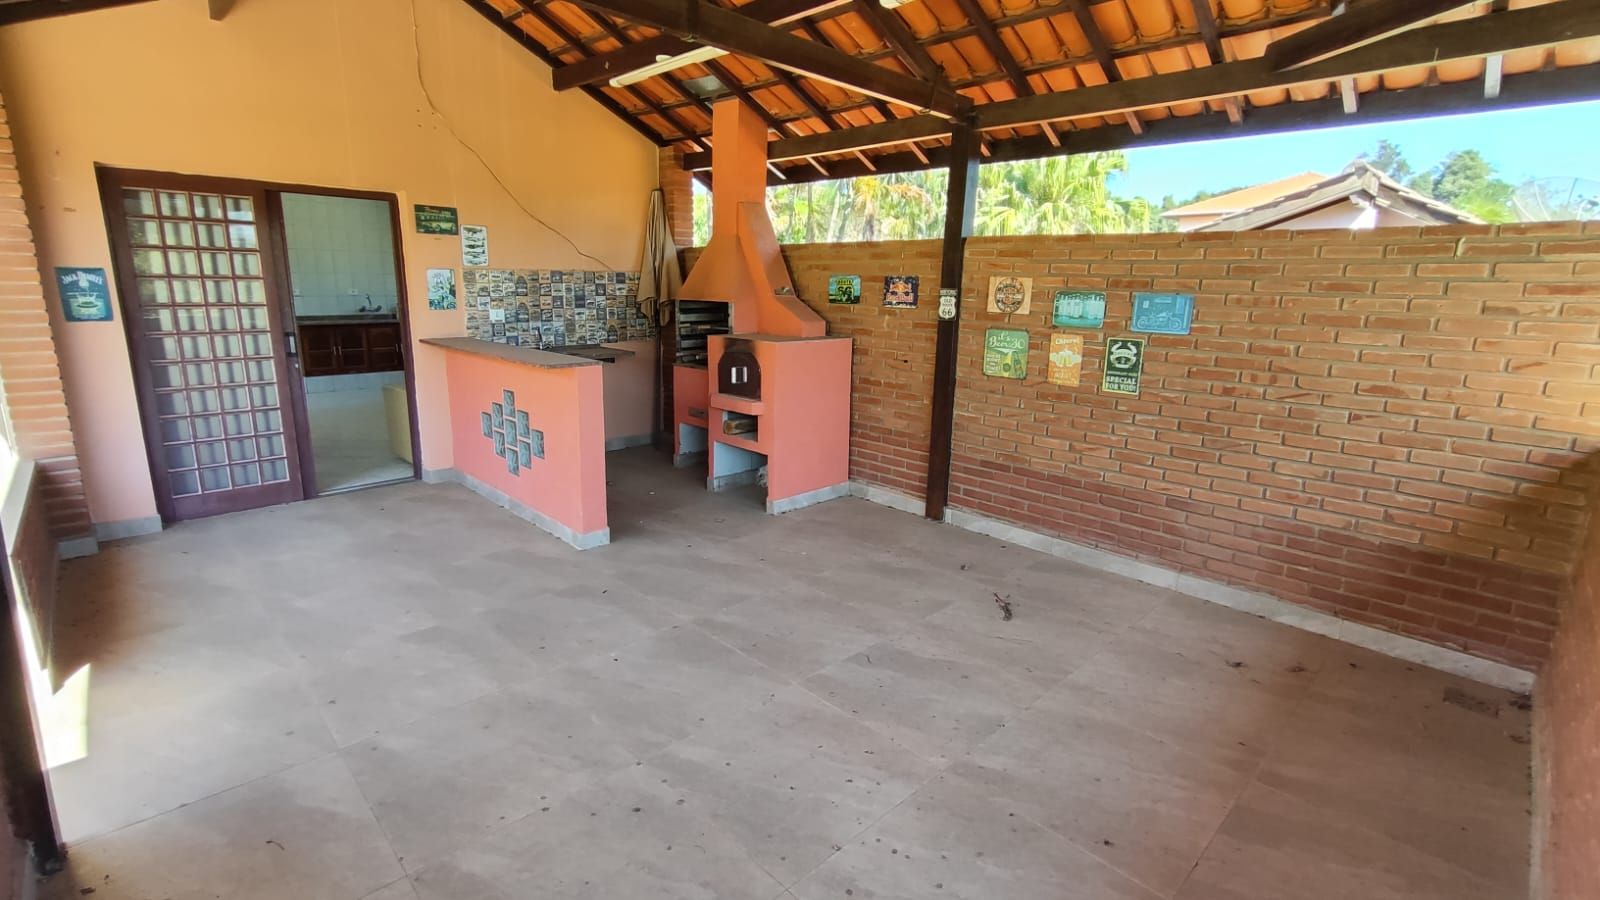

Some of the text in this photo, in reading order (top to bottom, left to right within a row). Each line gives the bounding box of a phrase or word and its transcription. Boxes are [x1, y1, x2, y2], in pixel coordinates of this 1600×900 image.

[61, 273, 78, 284] JACK
[941, 307, 953, 317] 66
[1106, 375, 1137, 385] SPECIAL
[1105, 382, 1119, 390] FOR
